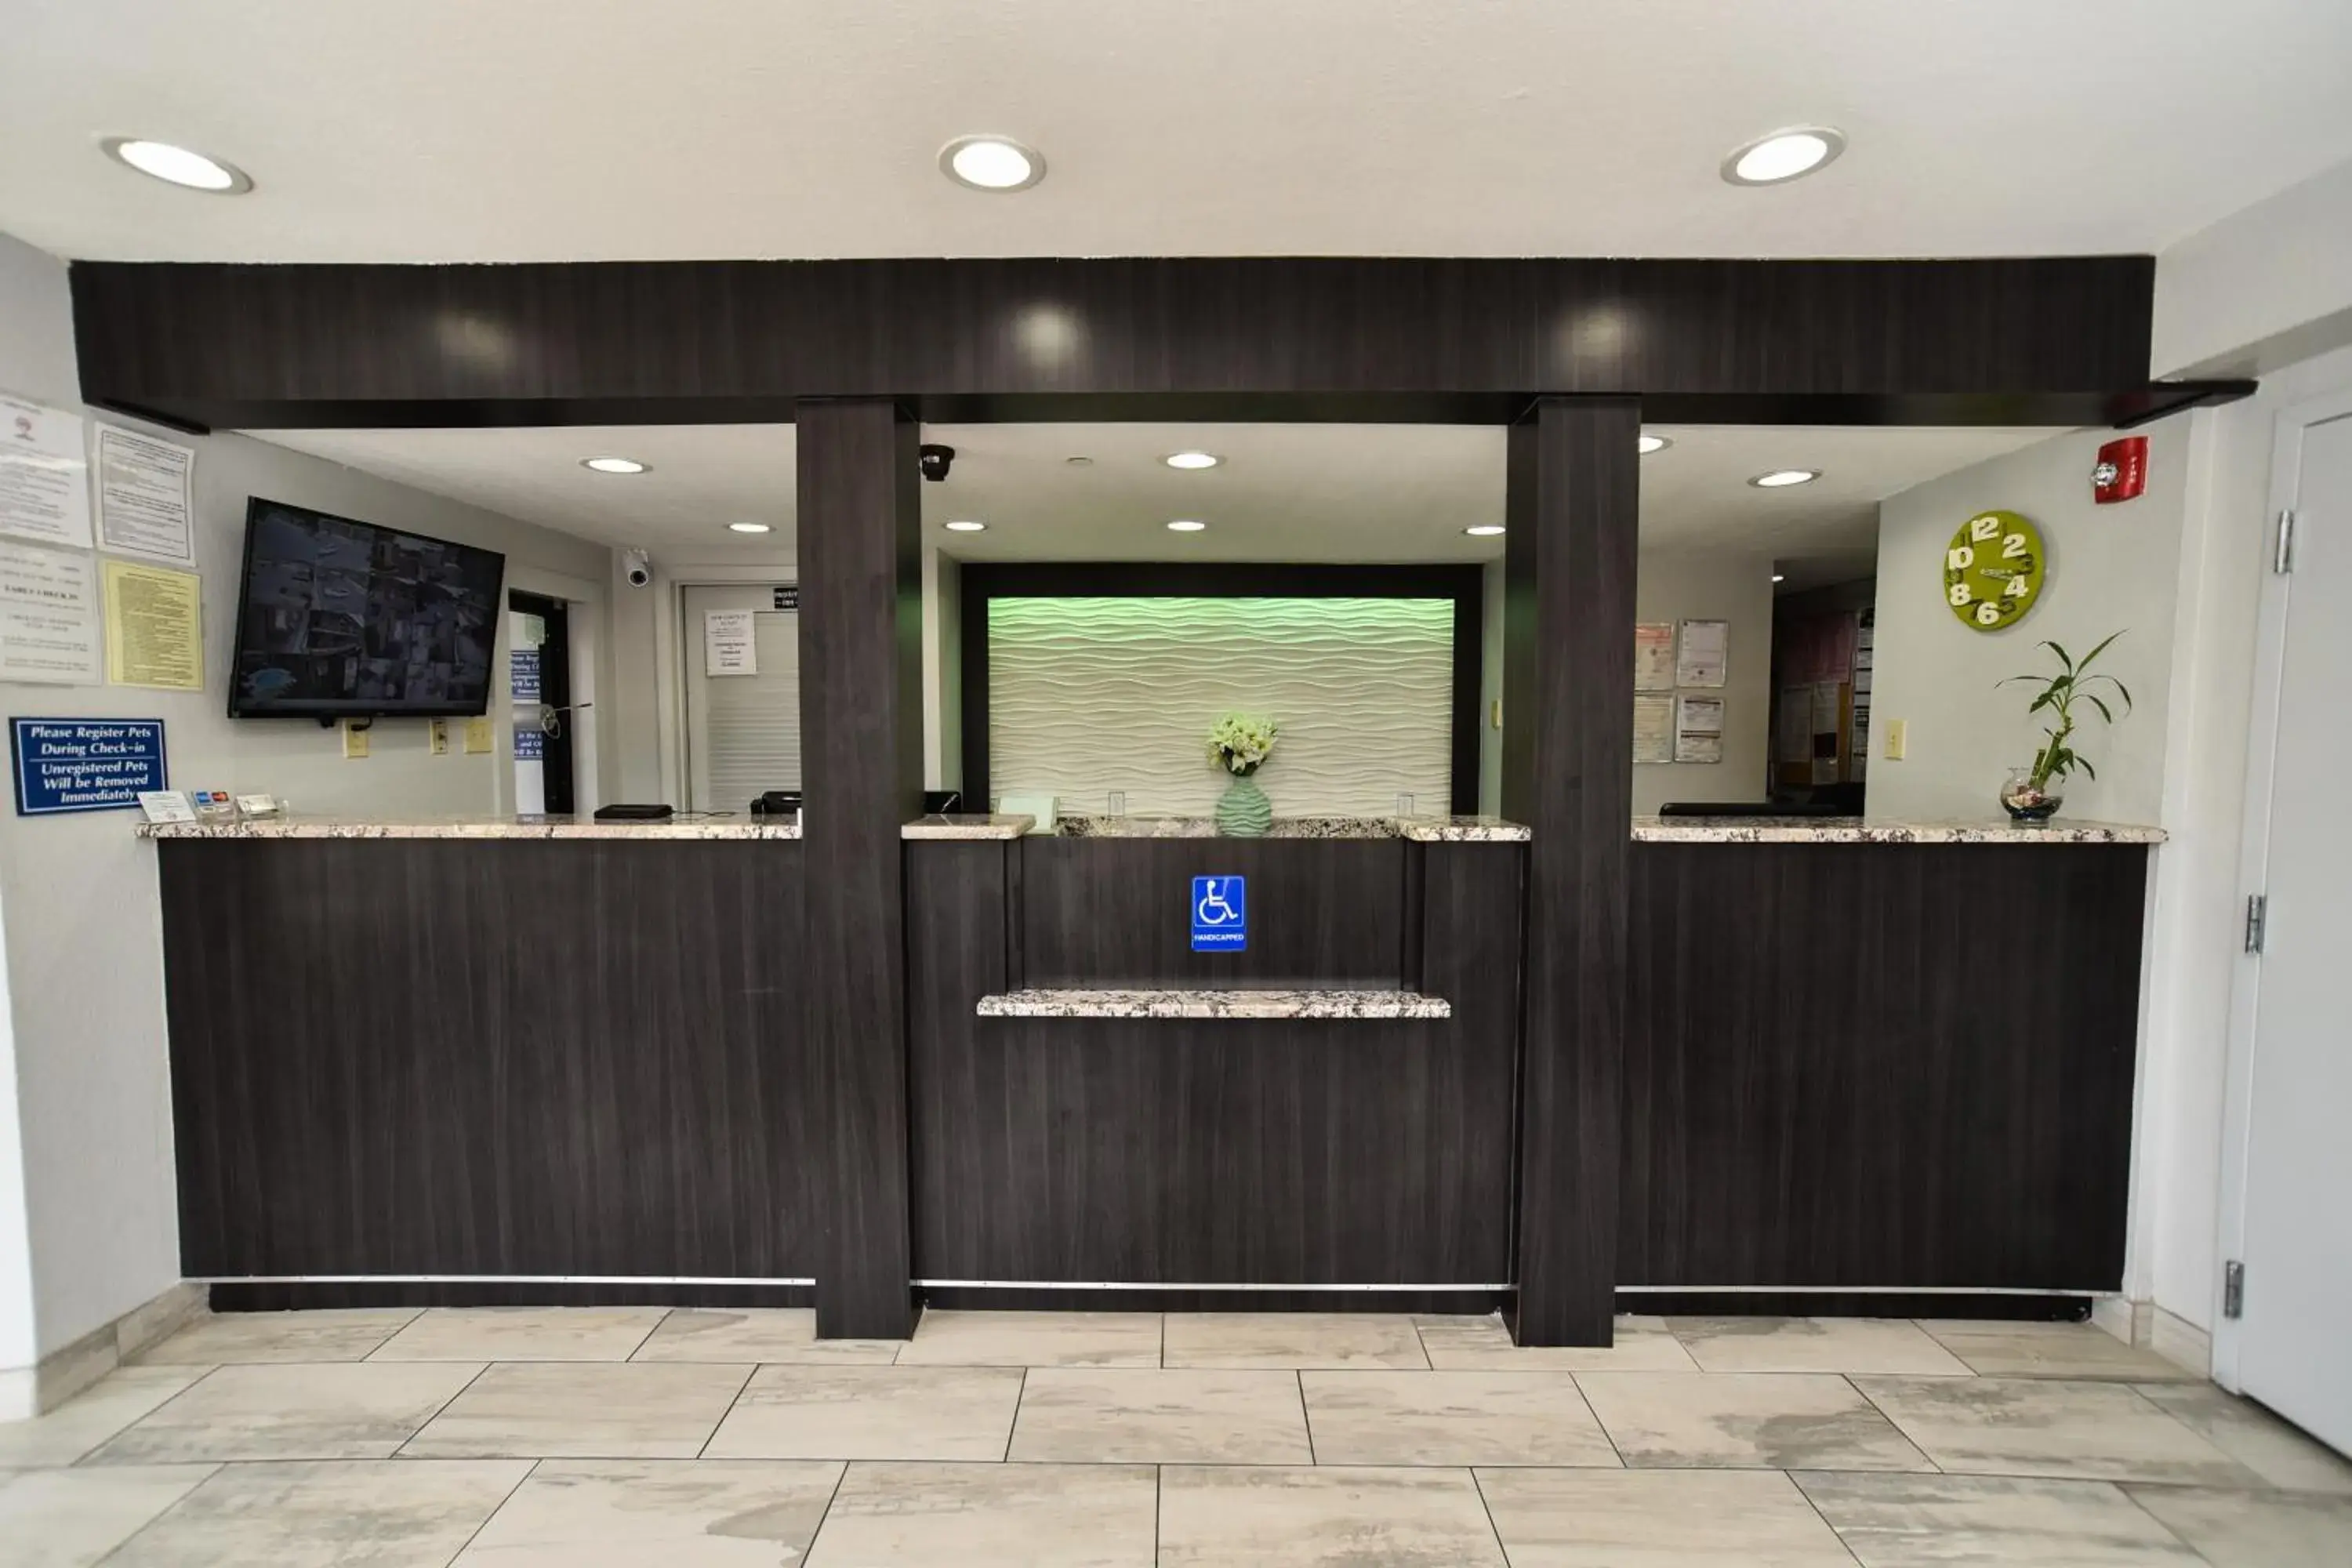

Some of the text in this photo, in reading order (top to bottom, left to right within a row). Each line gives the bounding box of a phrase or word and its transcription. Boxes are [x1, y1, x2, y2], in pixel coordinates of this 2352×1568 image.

[1971, 517, 1998, 543] 12
[2002, 533, 2026, 558] 2
[1948, 546, 1973, 570] 10
[1950, 583, 1971, 606] 8
[2005, 575, 2029, 597] 4
[1977, 601, 1999, 624] 6
[31, 727, 151, 741] Please Register Pets
[42, 742, 146, 756] During Check-in
[42, 760, 148, 777] Unregistered Pets
[44, 775, 148, 789] Will be Removed
